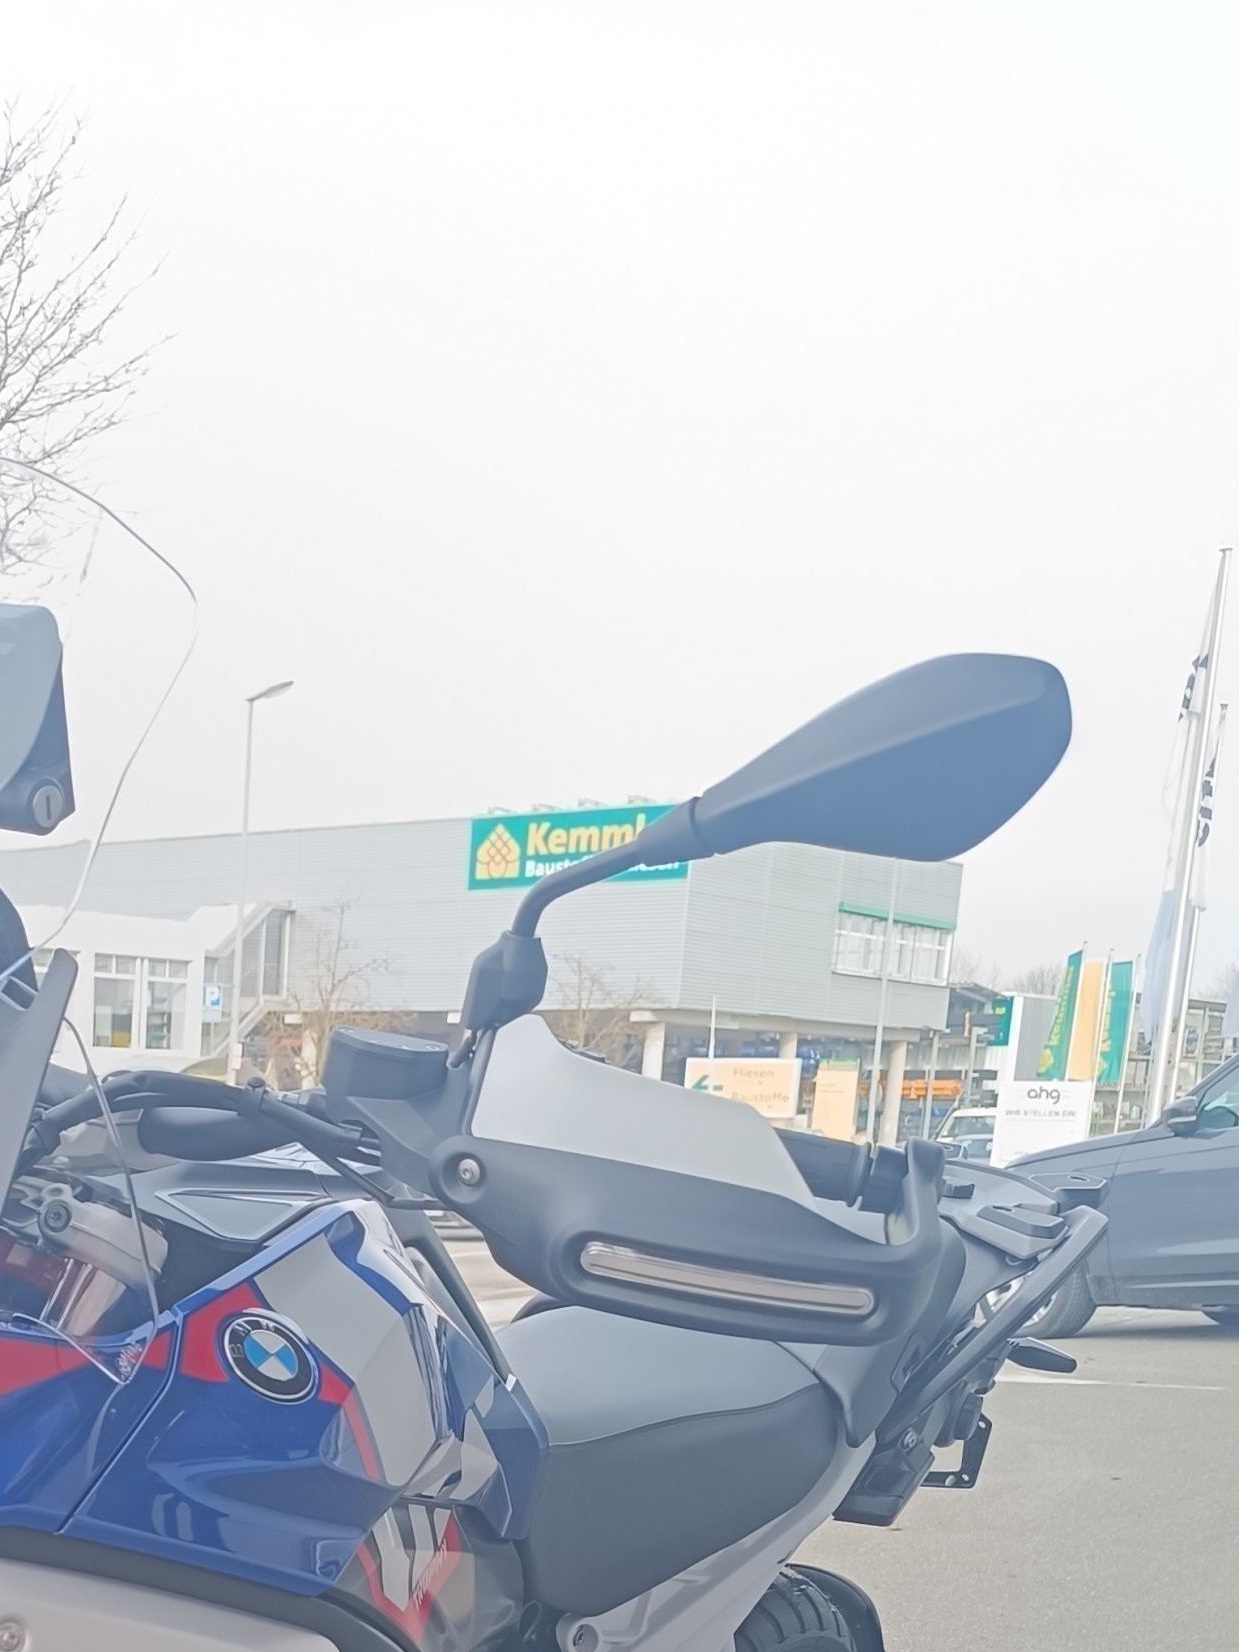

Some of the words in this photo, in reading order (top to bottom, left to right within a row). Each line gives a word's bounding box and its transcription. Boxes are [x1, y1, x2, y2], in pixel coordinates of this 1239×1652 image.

[526, 812, 647, 857] Kemml
[733, 1067, 775, 1079] Fliesen
[731, 1092, 790, 1104] Baustoffe
[1026, 1085, 1061, 1105] ahg
